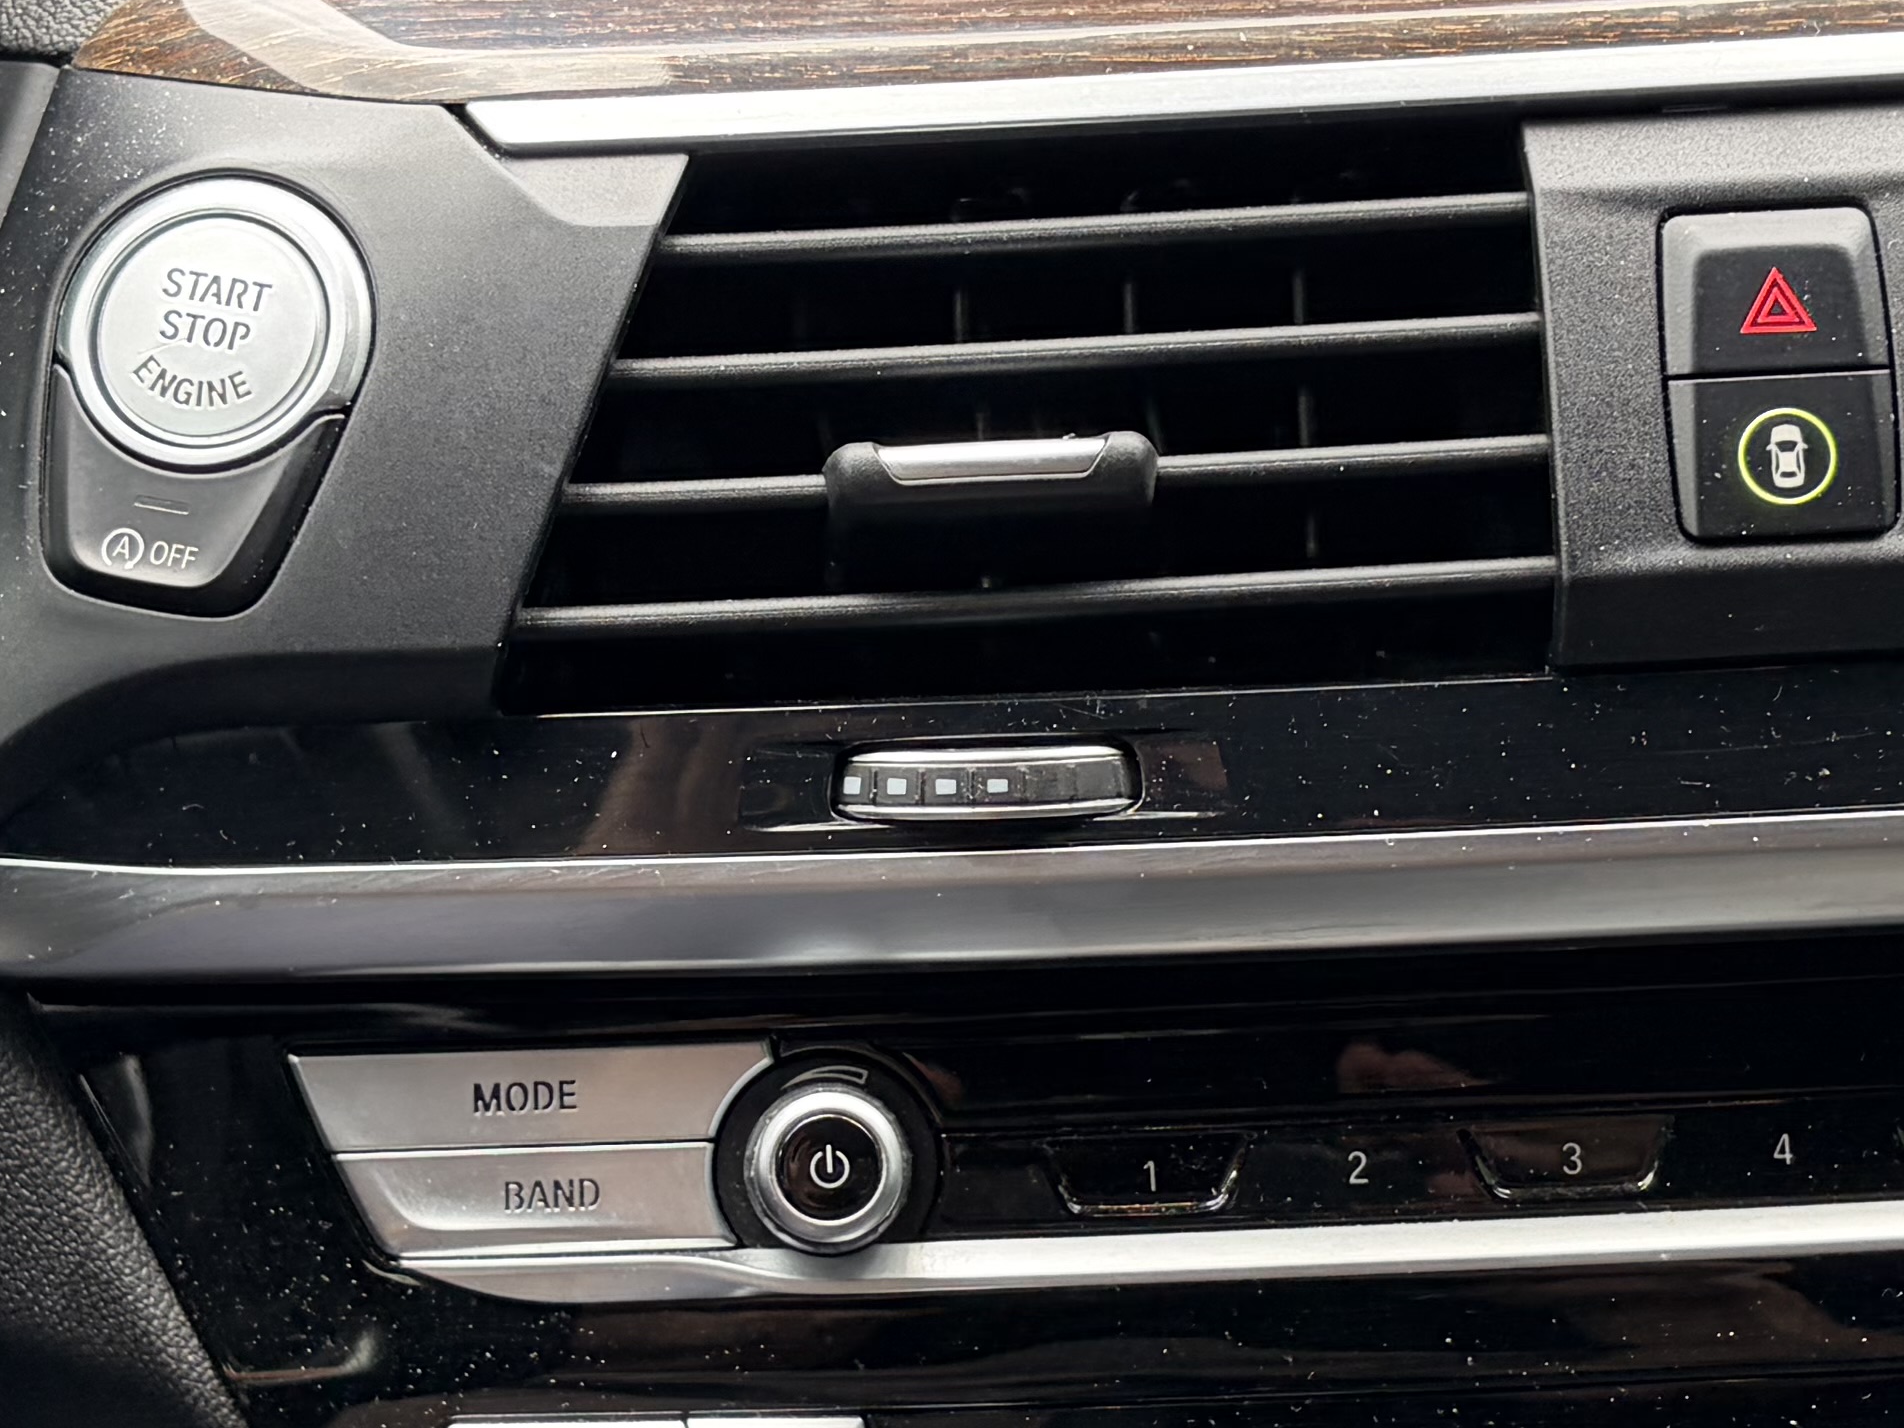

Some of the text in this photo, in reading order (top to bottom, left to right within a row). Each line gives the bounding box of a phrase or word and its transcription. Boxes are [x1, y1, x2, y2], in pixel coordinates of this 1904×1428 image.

[162, 268, 272, 312] START
[159, 310, 251, 351] STOP
[133, 355, 252, 408] ENGINE
[150, 541, 198, 569] OFF
[472, 1079, 577, 1116] MODE
[1562, 1143, 1582, 1174] 3
[1773, 1133, 1794, 1164] 4
[1143, 1161, 1157, 1192] 1
[1348, 1152, 1369, 1184] 2
[504, 1178, 600, 1213] BAND
